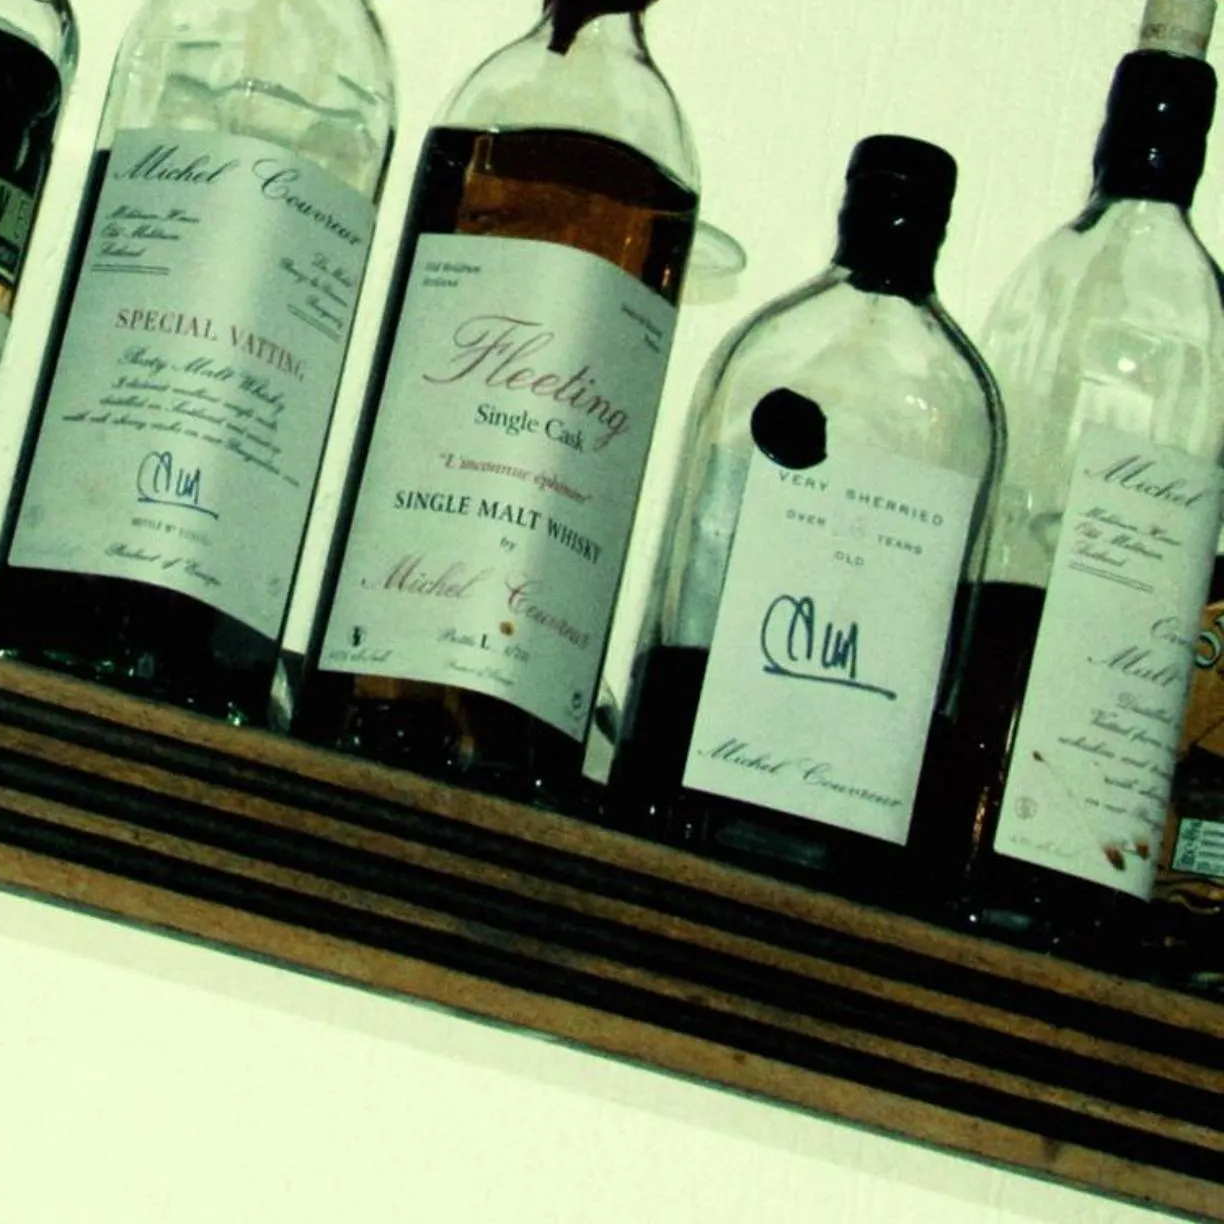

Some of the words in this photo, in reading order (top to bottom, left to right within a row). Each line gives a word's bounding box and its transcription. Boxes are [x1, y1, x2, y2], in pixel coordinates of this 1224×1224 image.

[113, 144, 239, 185] Michel
[252, 158, 362, 246] Couvreur
[114, 307, 218, 341] SPECIAL
[229, 325, 307, 382] VATTING
[422, 314, 630, 454] Fleeting
[475, 402, 540, 435] Single
[544, 416, 585, 454] Cask
[777, 471, 829, 492] VERY
[844, 488, 946, 528] SHERRIED
[1083, 454, 1204, 508] Michel
[394, 489, 471, 516] SINGLE
[476, 498, 542, 531] MALT
[547, 516, 604, 565] WHISKY
[500, 535, 518, 553] by
[786, 508, 827, 527] OVER
[834, 550, 866, 567] OLD
[360, 552, 496, 601] Michel
[504, 575, 592, 652] Couvreur
[697, 737, 790, 775] Michel
[791, 755, 903, 808] Couvreur
